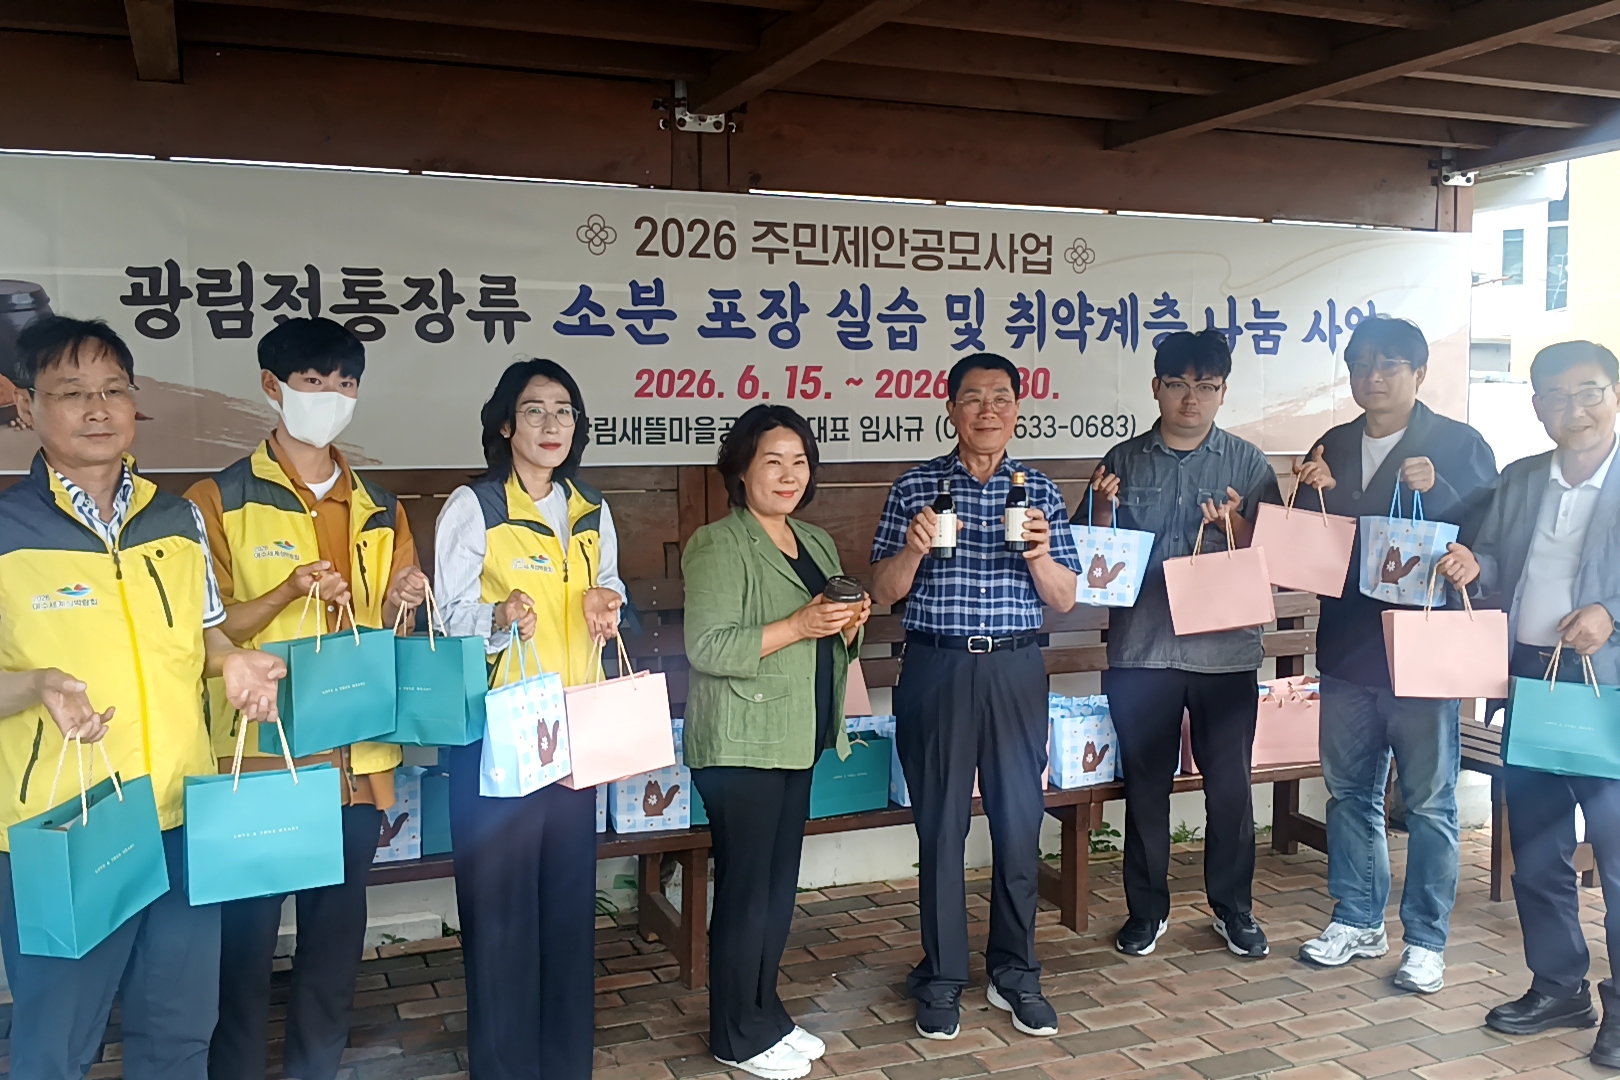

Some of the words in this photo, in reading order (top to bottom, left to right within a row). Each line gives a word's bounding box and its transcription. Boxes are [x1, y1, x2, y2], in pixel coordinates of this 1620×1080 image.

[634, 215, 737, 260] 2026
[752, 220, 1053, 275] 주민제안공모사업
[119, 258, 532, 345] 광림전통장류
[552, 277, 678, 345] 소분
[697, 281, 811, 349] 포장
[826, 283, 927, 351] 실습
[945, 287, 986, 351] 및
[1004, 288, 1188, 355] 취약계층
[1204, 295, 1288, 355] 나눔
[634, 368, 725, 399] 2026.
[737, 365, 770, 400] 6.
[785, 365, 832, 400] 15.
[845, 376, 864, 387] ~
[807, 415, 851, 443] 대표
[860, 415, 924, 443] 임사규
